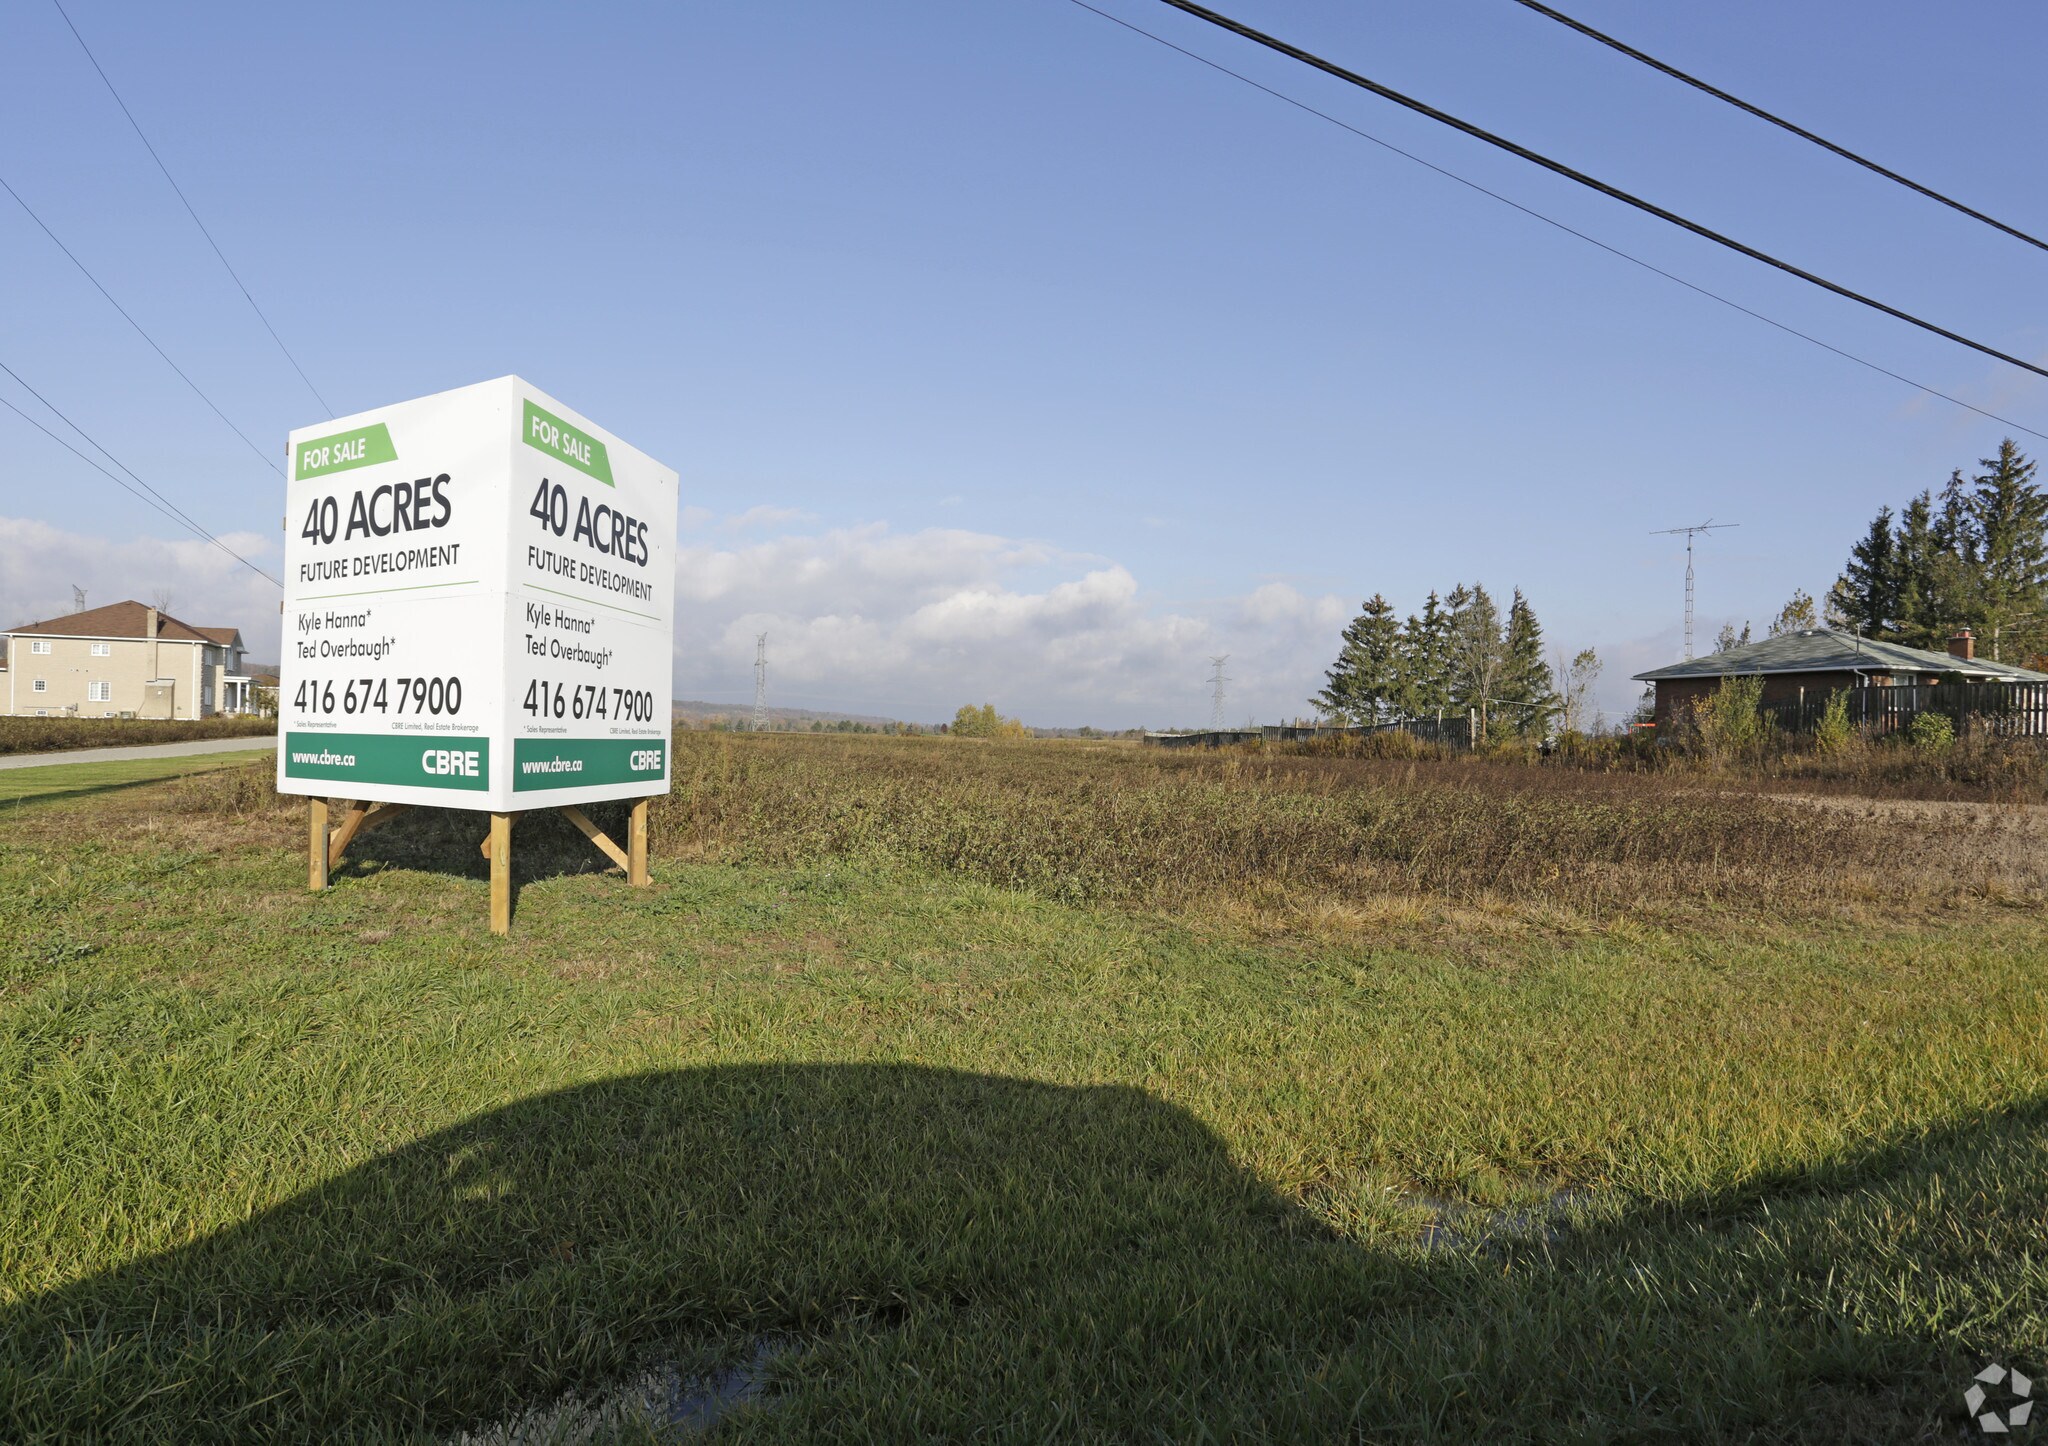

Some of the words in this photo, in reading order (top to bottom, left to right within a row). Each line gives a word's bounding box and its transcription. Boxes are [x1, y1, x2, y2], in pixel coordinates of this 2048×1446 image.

[303, 446, 329, 470] FOR
[333, 438, 366, 464] SALE
[532, 415, 559, 450] FOR
[562, 433, 591, 466] SALE
[302, 495, 338, 545] 40
[344, 473, 452, 541] ACRES
[530, 477, 568, 537] 40
[573, 495, 648, 567] ACRES
[300, 558, 348, 582] FUTURE
[353, 543, 460, 576] DEVELOPMENT
[528, 545, 576, 579] FUTURE
[580, 562, 652, 602] DEVELOPMENT
[298, 611, 321, 635] Kyle
[526, 602, 551, 629] Kyle
[297, 640, 317, 659] Ted
[525, 634, 547, 656] Ted
[294, 679, 335, 714] 416
[343, 678, 388, 714] 674
[397, 676, 462, 715] 7900
[523, 679, 566, 719] 416
[572, 684, 607, 720] 674
[613, 688, 653, 722] 7900
[307, 720, 337, 729] Representative
[391, 722, 404, 730] CBRE
[424, 722, 435, 731] Real
[436, 723, 451, 731] Estate
[452, 723, 479, 733] Brokerage
[526, 725, 538, 733] Sales
[292, 748, 355, 767] www.cbre.ca
[422, 749, 479, 777] CBRE
[522, 755, 583, 774] www.cbre.ca
[630, 750, 661, 771] CBRE
